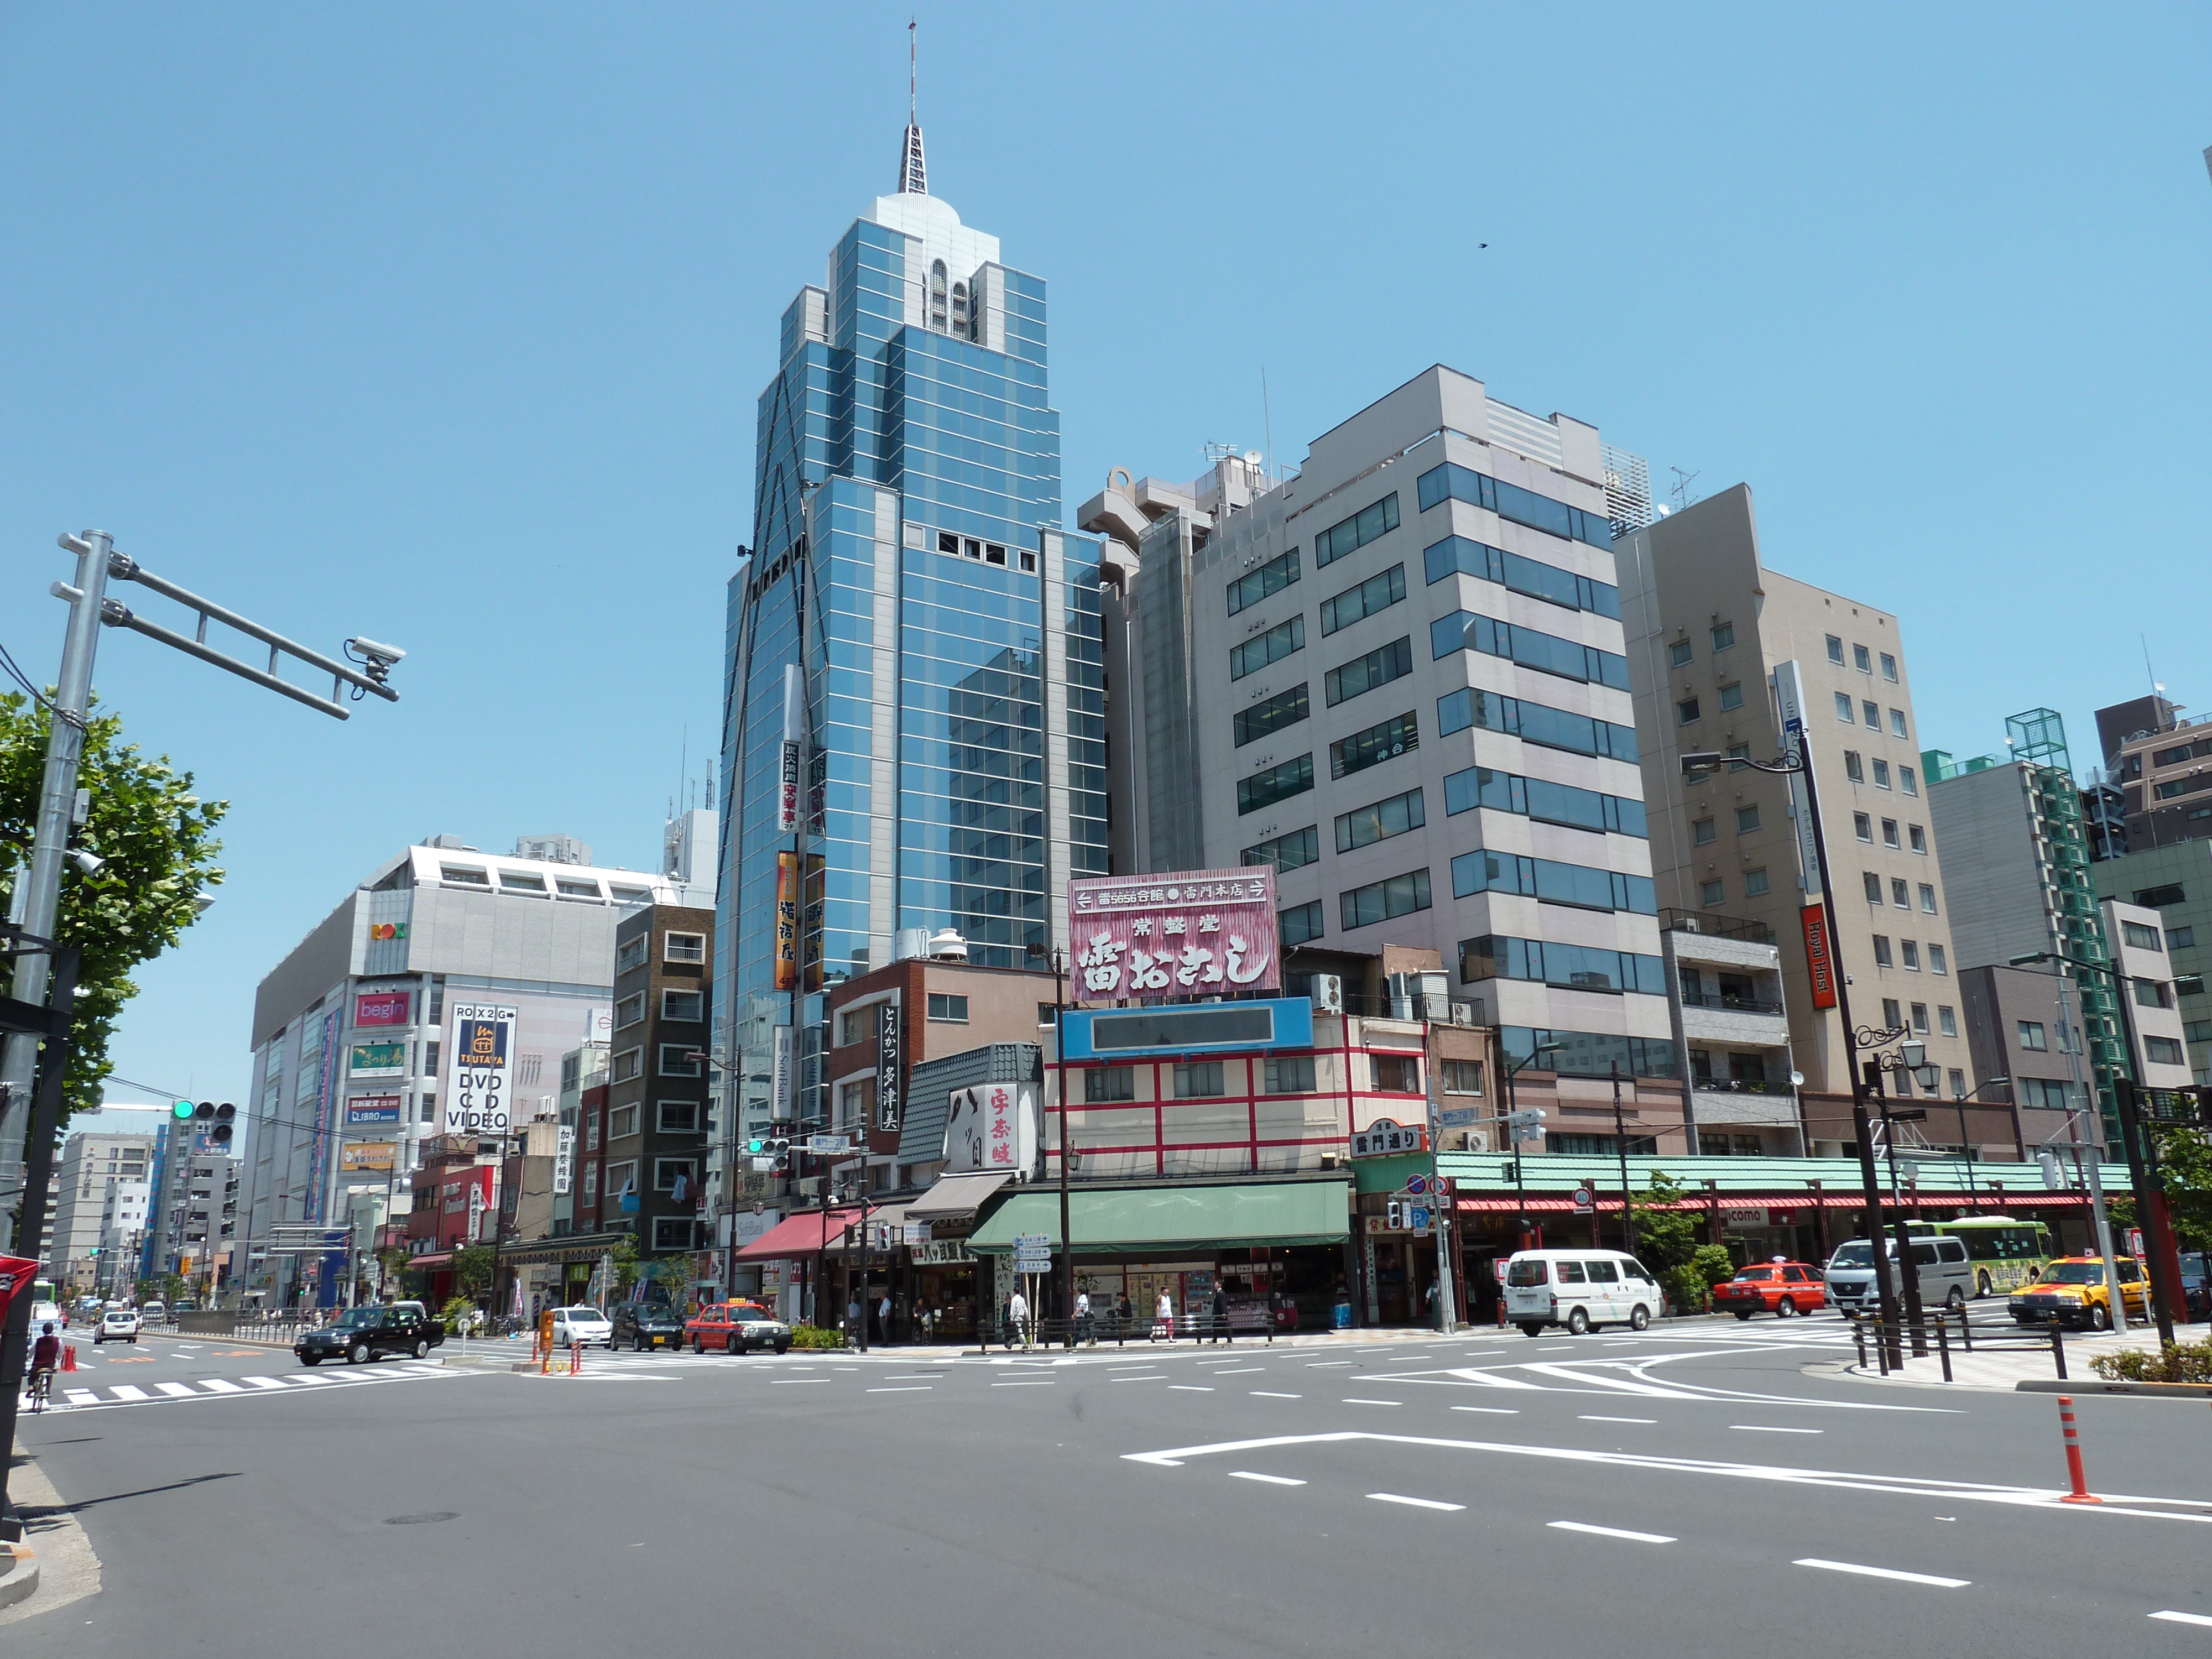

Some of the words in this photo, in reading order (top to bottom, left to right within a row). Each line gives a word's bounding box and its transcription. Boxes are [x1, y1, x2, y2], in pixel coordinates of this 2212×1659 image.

[1184, 883, 1243, 900] 雷門本店
[371, 922, 405, 940] ROX
[1808, 920, 1825, 958] Royal
[1814, 960, 1829, 994] Host
[361, 999, 404, 1019] begin
[883, 1008, 896, 1058] とんかつ
[459, 1073, 502, 1090] DVD
[778, 1055, 788, 1105] SoftBank
[883, 1066, 897, 1129] 多津美
[355, 1112, 380, 1121] LIBRO
[447, 1111, 508, 1128] VIDEO
[1376, 1122, 1391, 1131] 浅草
[1356, 1130, 1414, 1154] 雷門通り
[1577, 1193, 1588, 1202] 40
[1413, 1213, 1421, 1226] P
[738, 1220, 764, 1237] SoftBank
